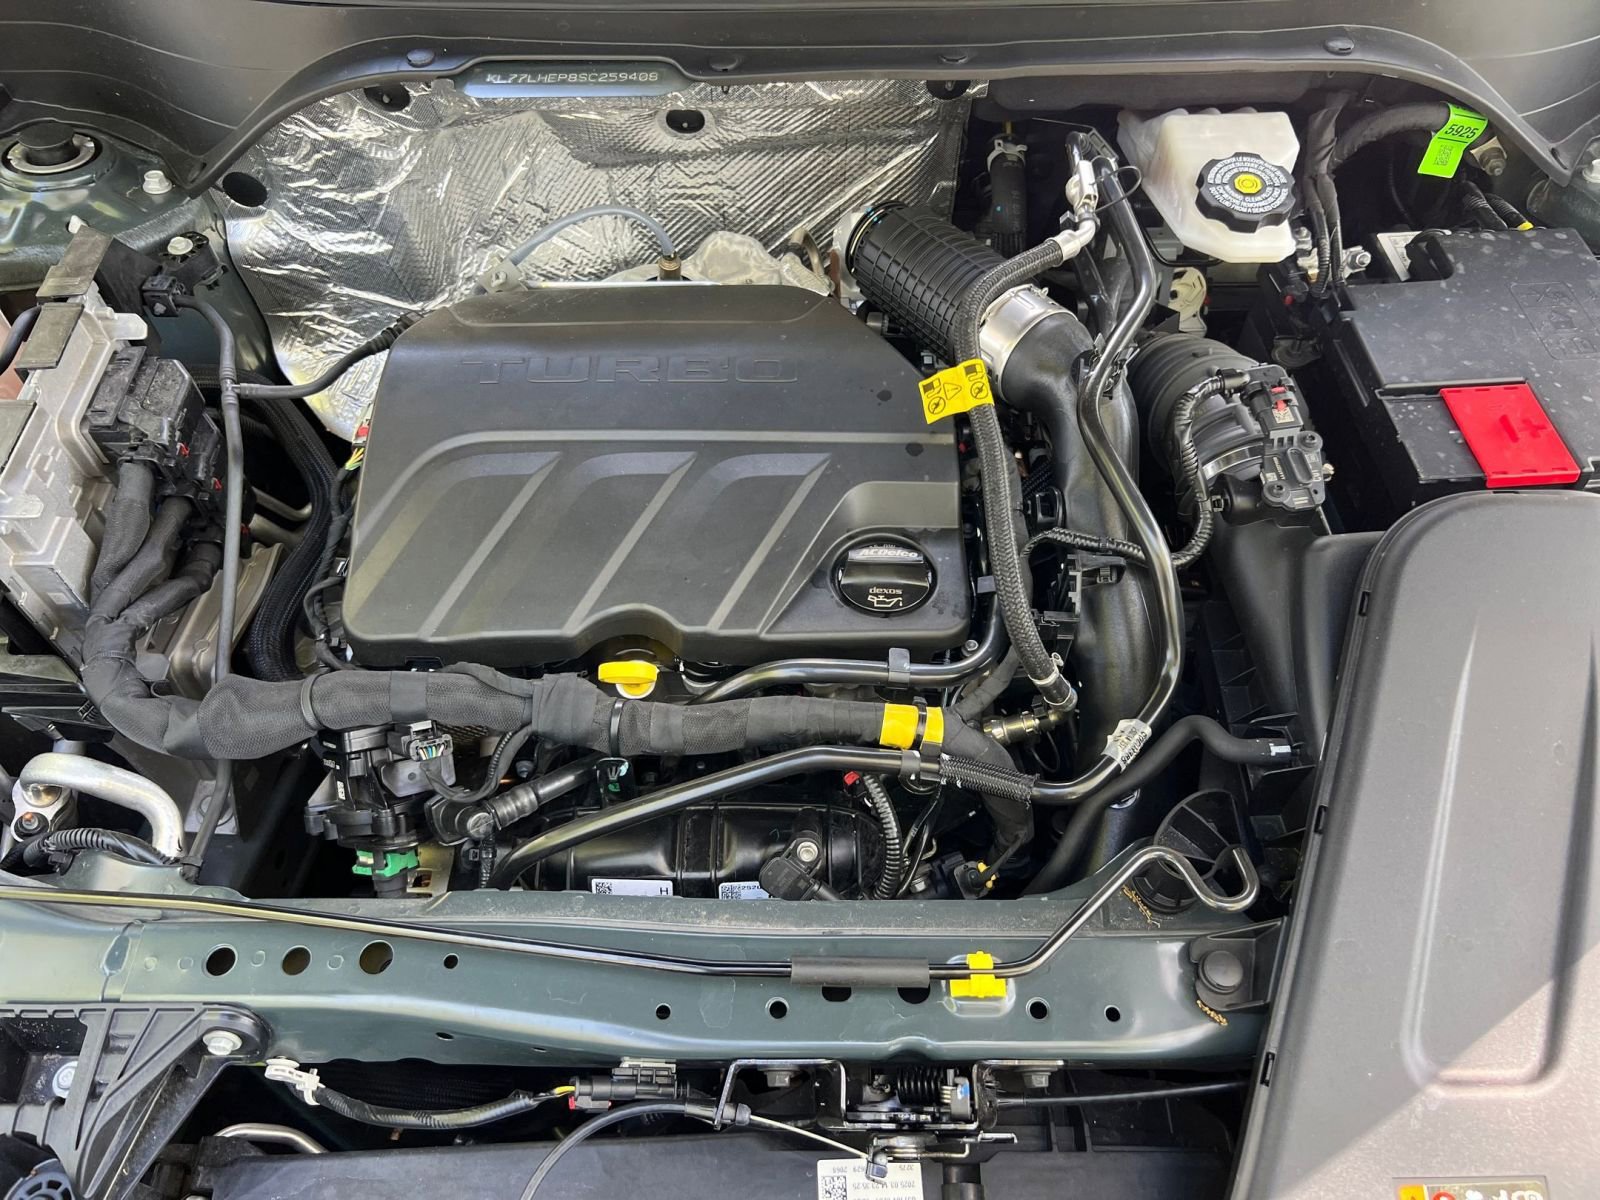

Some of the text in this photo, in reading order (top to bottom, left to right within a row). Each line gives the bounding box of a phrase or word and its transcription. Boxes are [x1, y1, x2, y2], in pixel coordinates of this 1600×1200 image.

[485, 72, 658, 84] KL77LHEP8SC259408
[1445, 124, 1479, 139] 5925
[462, 355, 799, 384] TURBO
[859, 548, 919, 557] ACDelco
[869, 586, 903, 595] dexos
